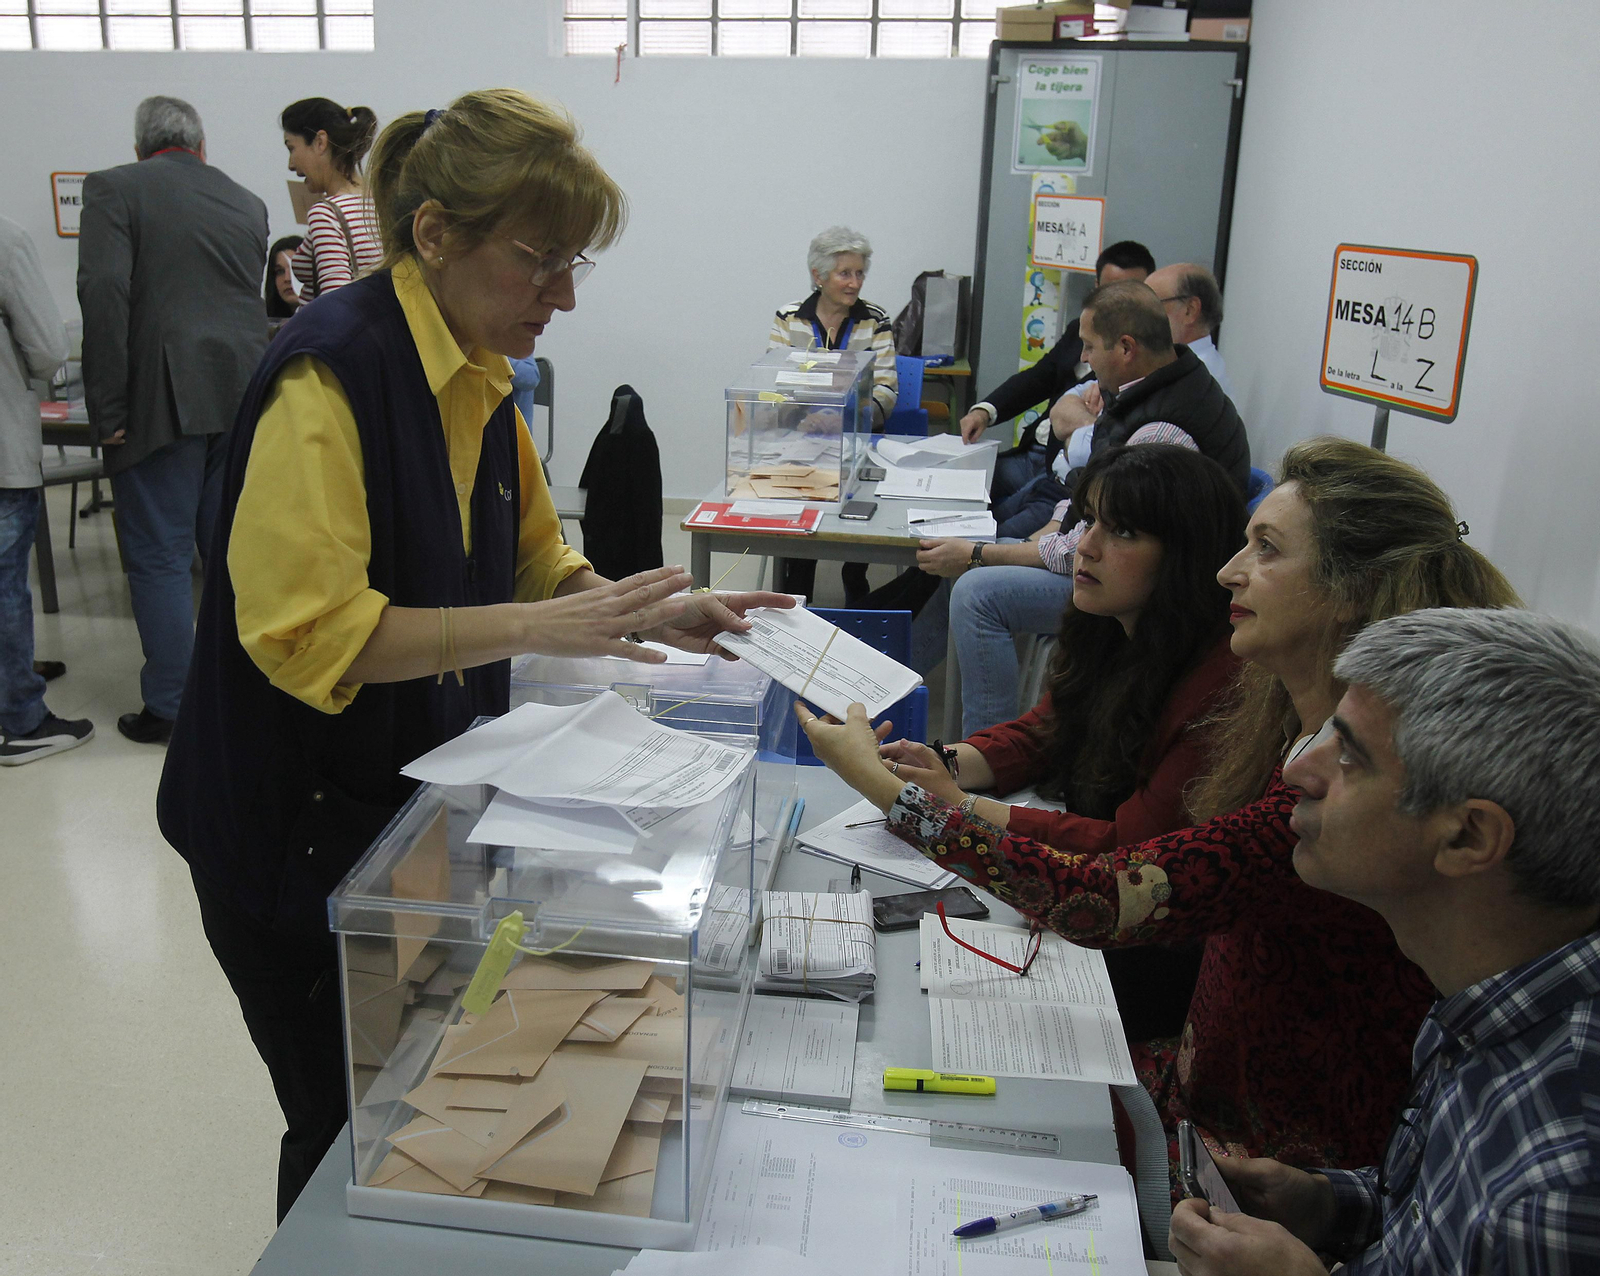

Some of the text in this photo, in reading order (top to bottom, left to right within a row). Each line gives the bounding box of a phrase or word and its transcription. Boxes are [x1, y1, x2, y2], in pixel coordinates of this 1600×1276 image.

[1028, 63, 1089, 77] Coge bien
[1035, 81, 1083, 94] la tijera
[60, 195, 83, 206] ME
[1037, 220, 1064, 234] MESA
[1340, 258, 1382, 274] SECCIÓN
[1335, 299, 1387, 328] MESA
[1327, 366, 1337, 375] De
[1337, 368, 1344, 377] la
[1344, 369, 1361, 381] letra
[1370, 349, 1387, 382] L
[1396, 382, 1403, 391] la
[1414, 357, 1435, 392] Z
